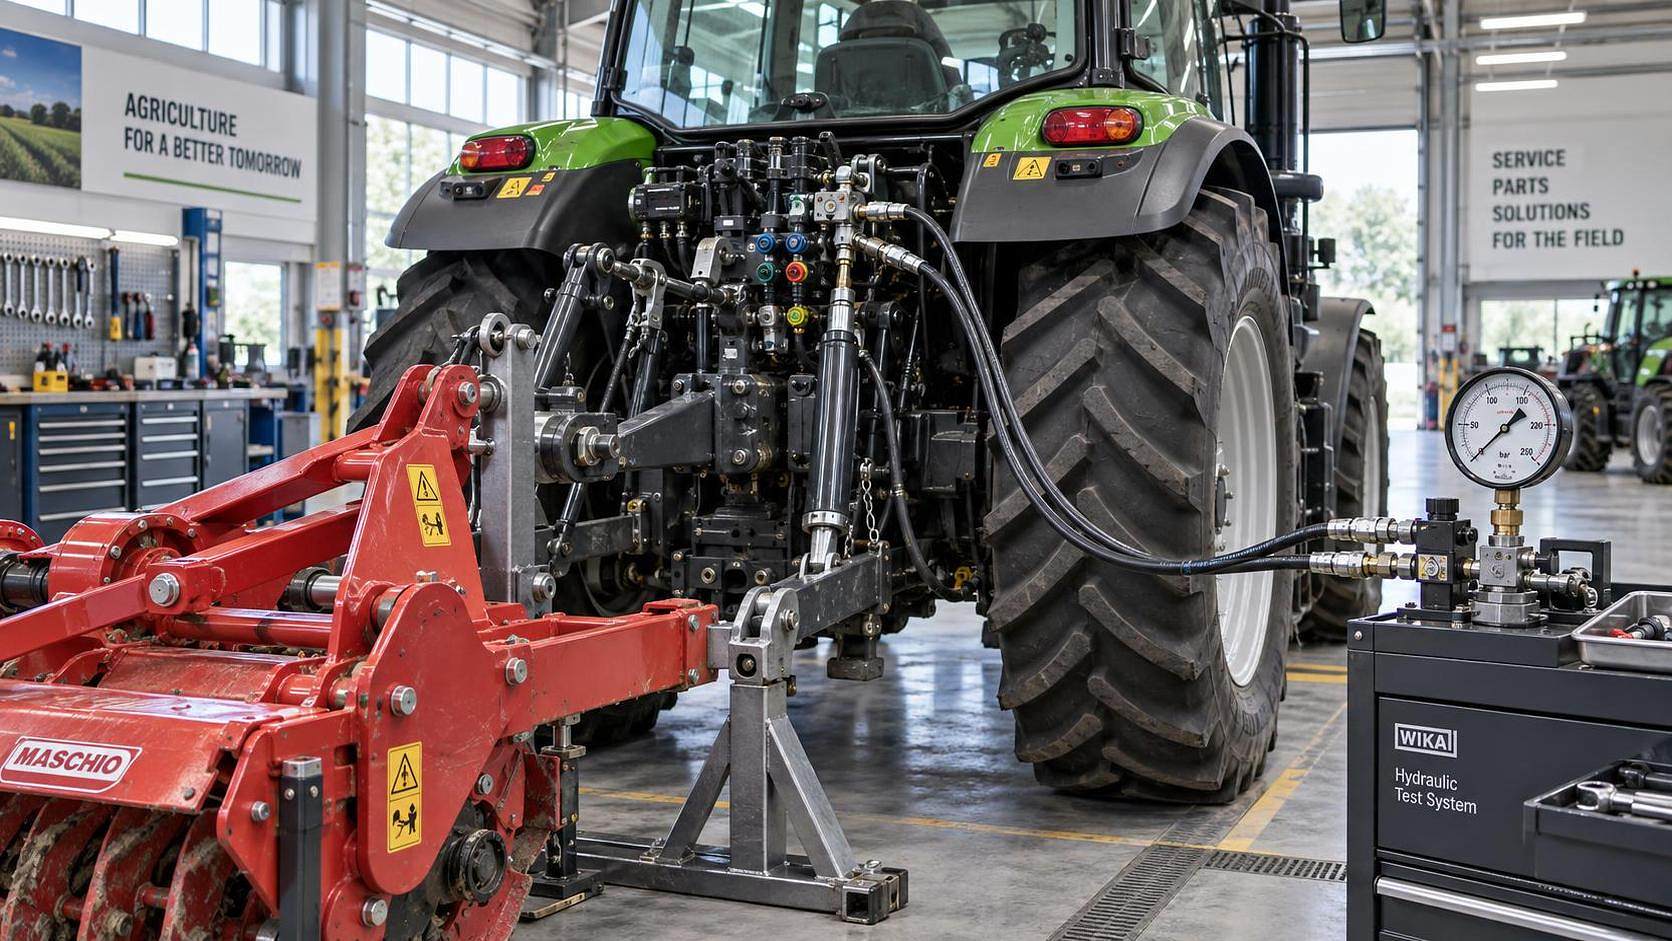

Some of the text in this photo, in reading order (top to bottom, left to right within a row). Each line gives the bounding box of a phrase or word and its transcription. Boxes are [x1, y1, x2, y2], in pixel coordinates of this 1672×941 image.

[125, 93, 237, 137] AGRICULTURE
[124, 127, 301, 179] FOR A BETTER TOMORROW
[1493, 149, 1565, 168] SERVICE
[1493, 178, 1548, 195] PARTS
[1493, 203, 1590, 221] SOLUTIONS
[1493, 229, 1623, 248] FOR THE FIELD
[1400, 729, 1447, 750] WIKA
[14, 746, 122, 774] MASCHIO
[1395, 767, 1458, 790] Hydraulic
[1395, 786, 1477, 814] Test System
